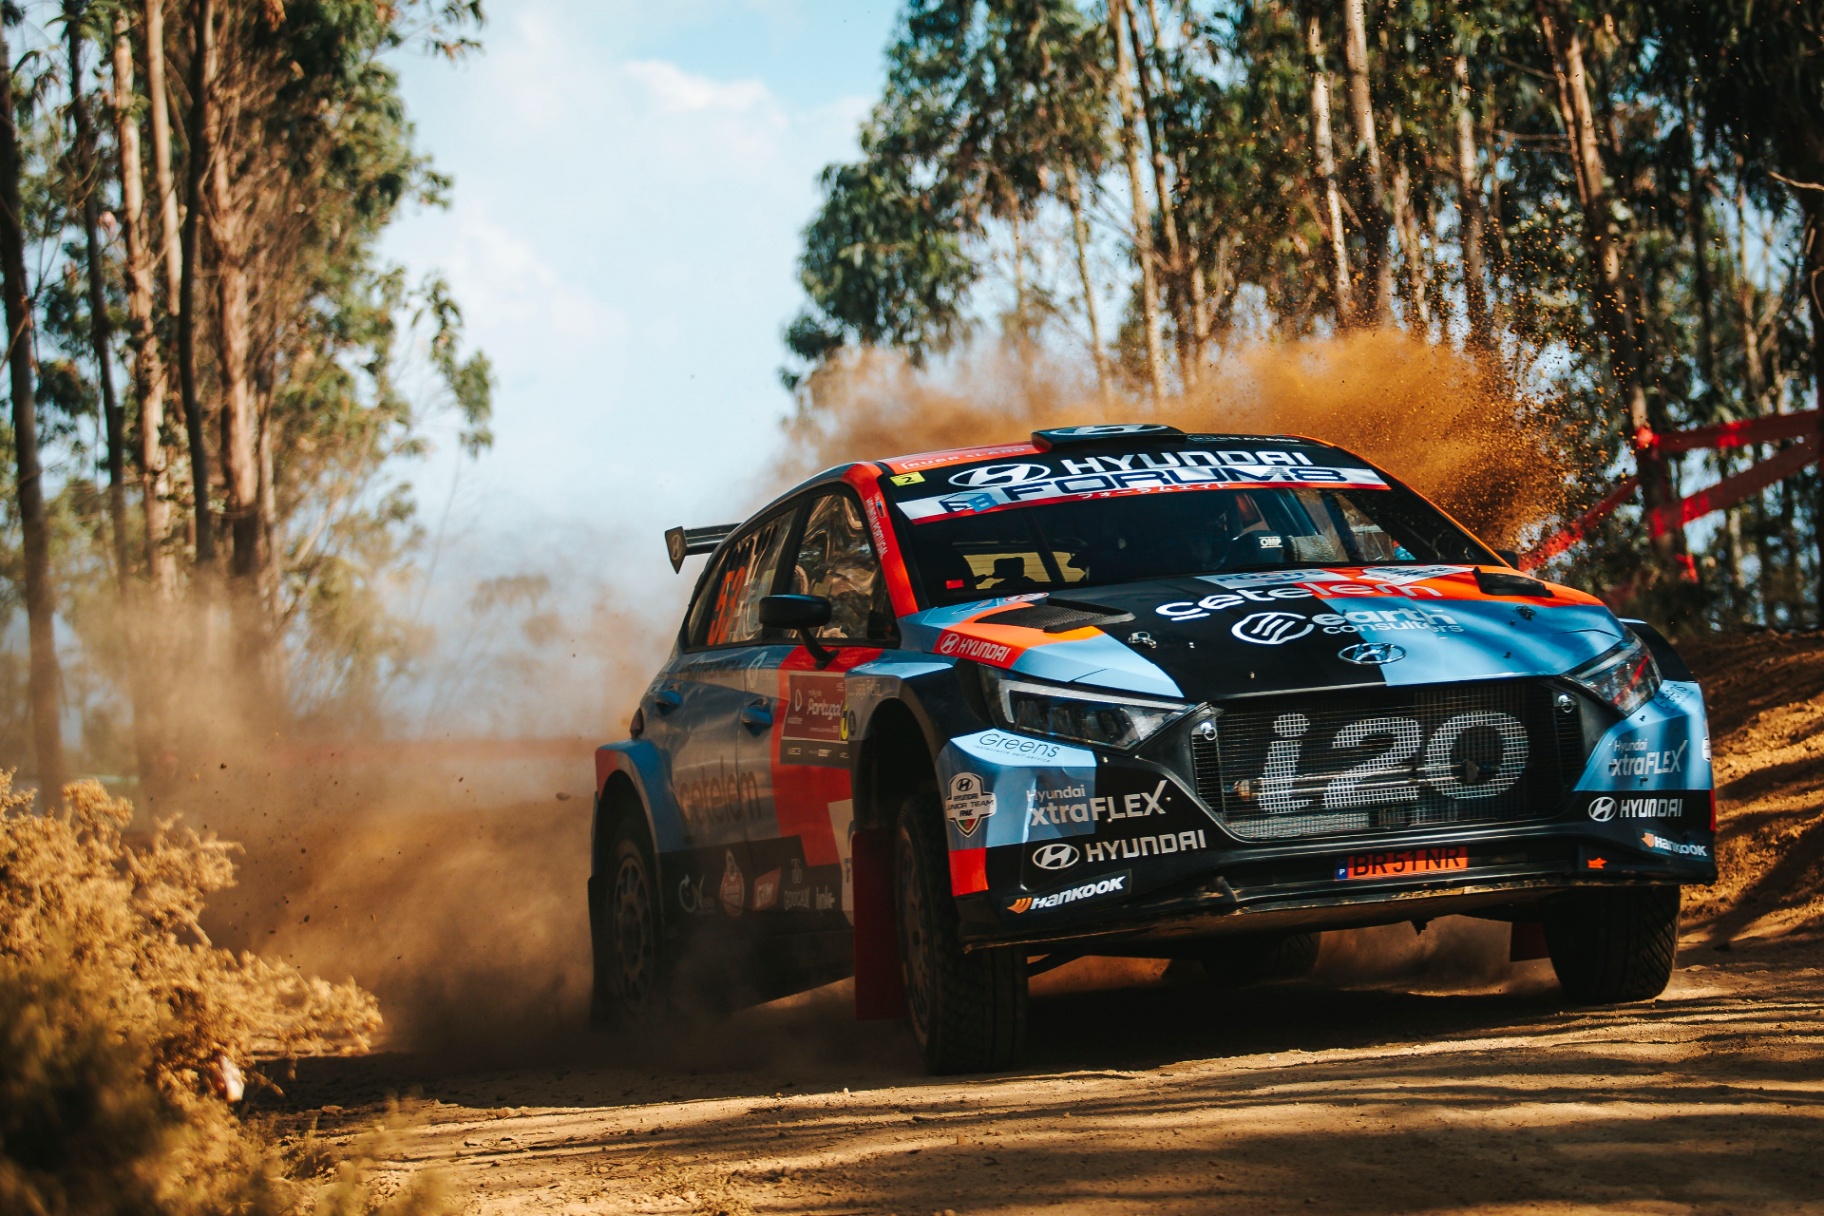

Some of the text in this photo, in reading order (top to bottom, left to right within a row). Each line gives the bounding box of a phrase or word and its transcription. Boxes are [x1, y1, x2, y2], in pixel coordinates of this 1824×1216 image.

[1060, 451, 1313, 475] HYUNDAI
[902, 475, 913, 484] 2
[1001, 467, 1347, 501] FORUM8
[1260, 538, 1282, 546] OMP
[1155, 582, 1443, 622] cetelem
[1311, 607, 1458, 626] earth
[957, 637, 1012, 662] HYUNDAI
[806, 698, 843, 720] Portugal
[979, 733, 1060, 758] Greens
[1613, 738, 1649, 753] Hyundai
[1257, 710, 1531, 813] i20
[1611, 740, 1689, 777] xtraFLEX
[677, 754, 761, 826] cetelem
[953, 793, 979, 801] HYUNDAI
[1026, 784, 1086, 804] Hyundai
[971, 800, 994, 808] TEAM
[1029, 780, 1168, 827] xtraFLEX
[1619, 798, 1683, 818] HYUNDAI
[1086, 829, 1207, 863] HYUNDAI
